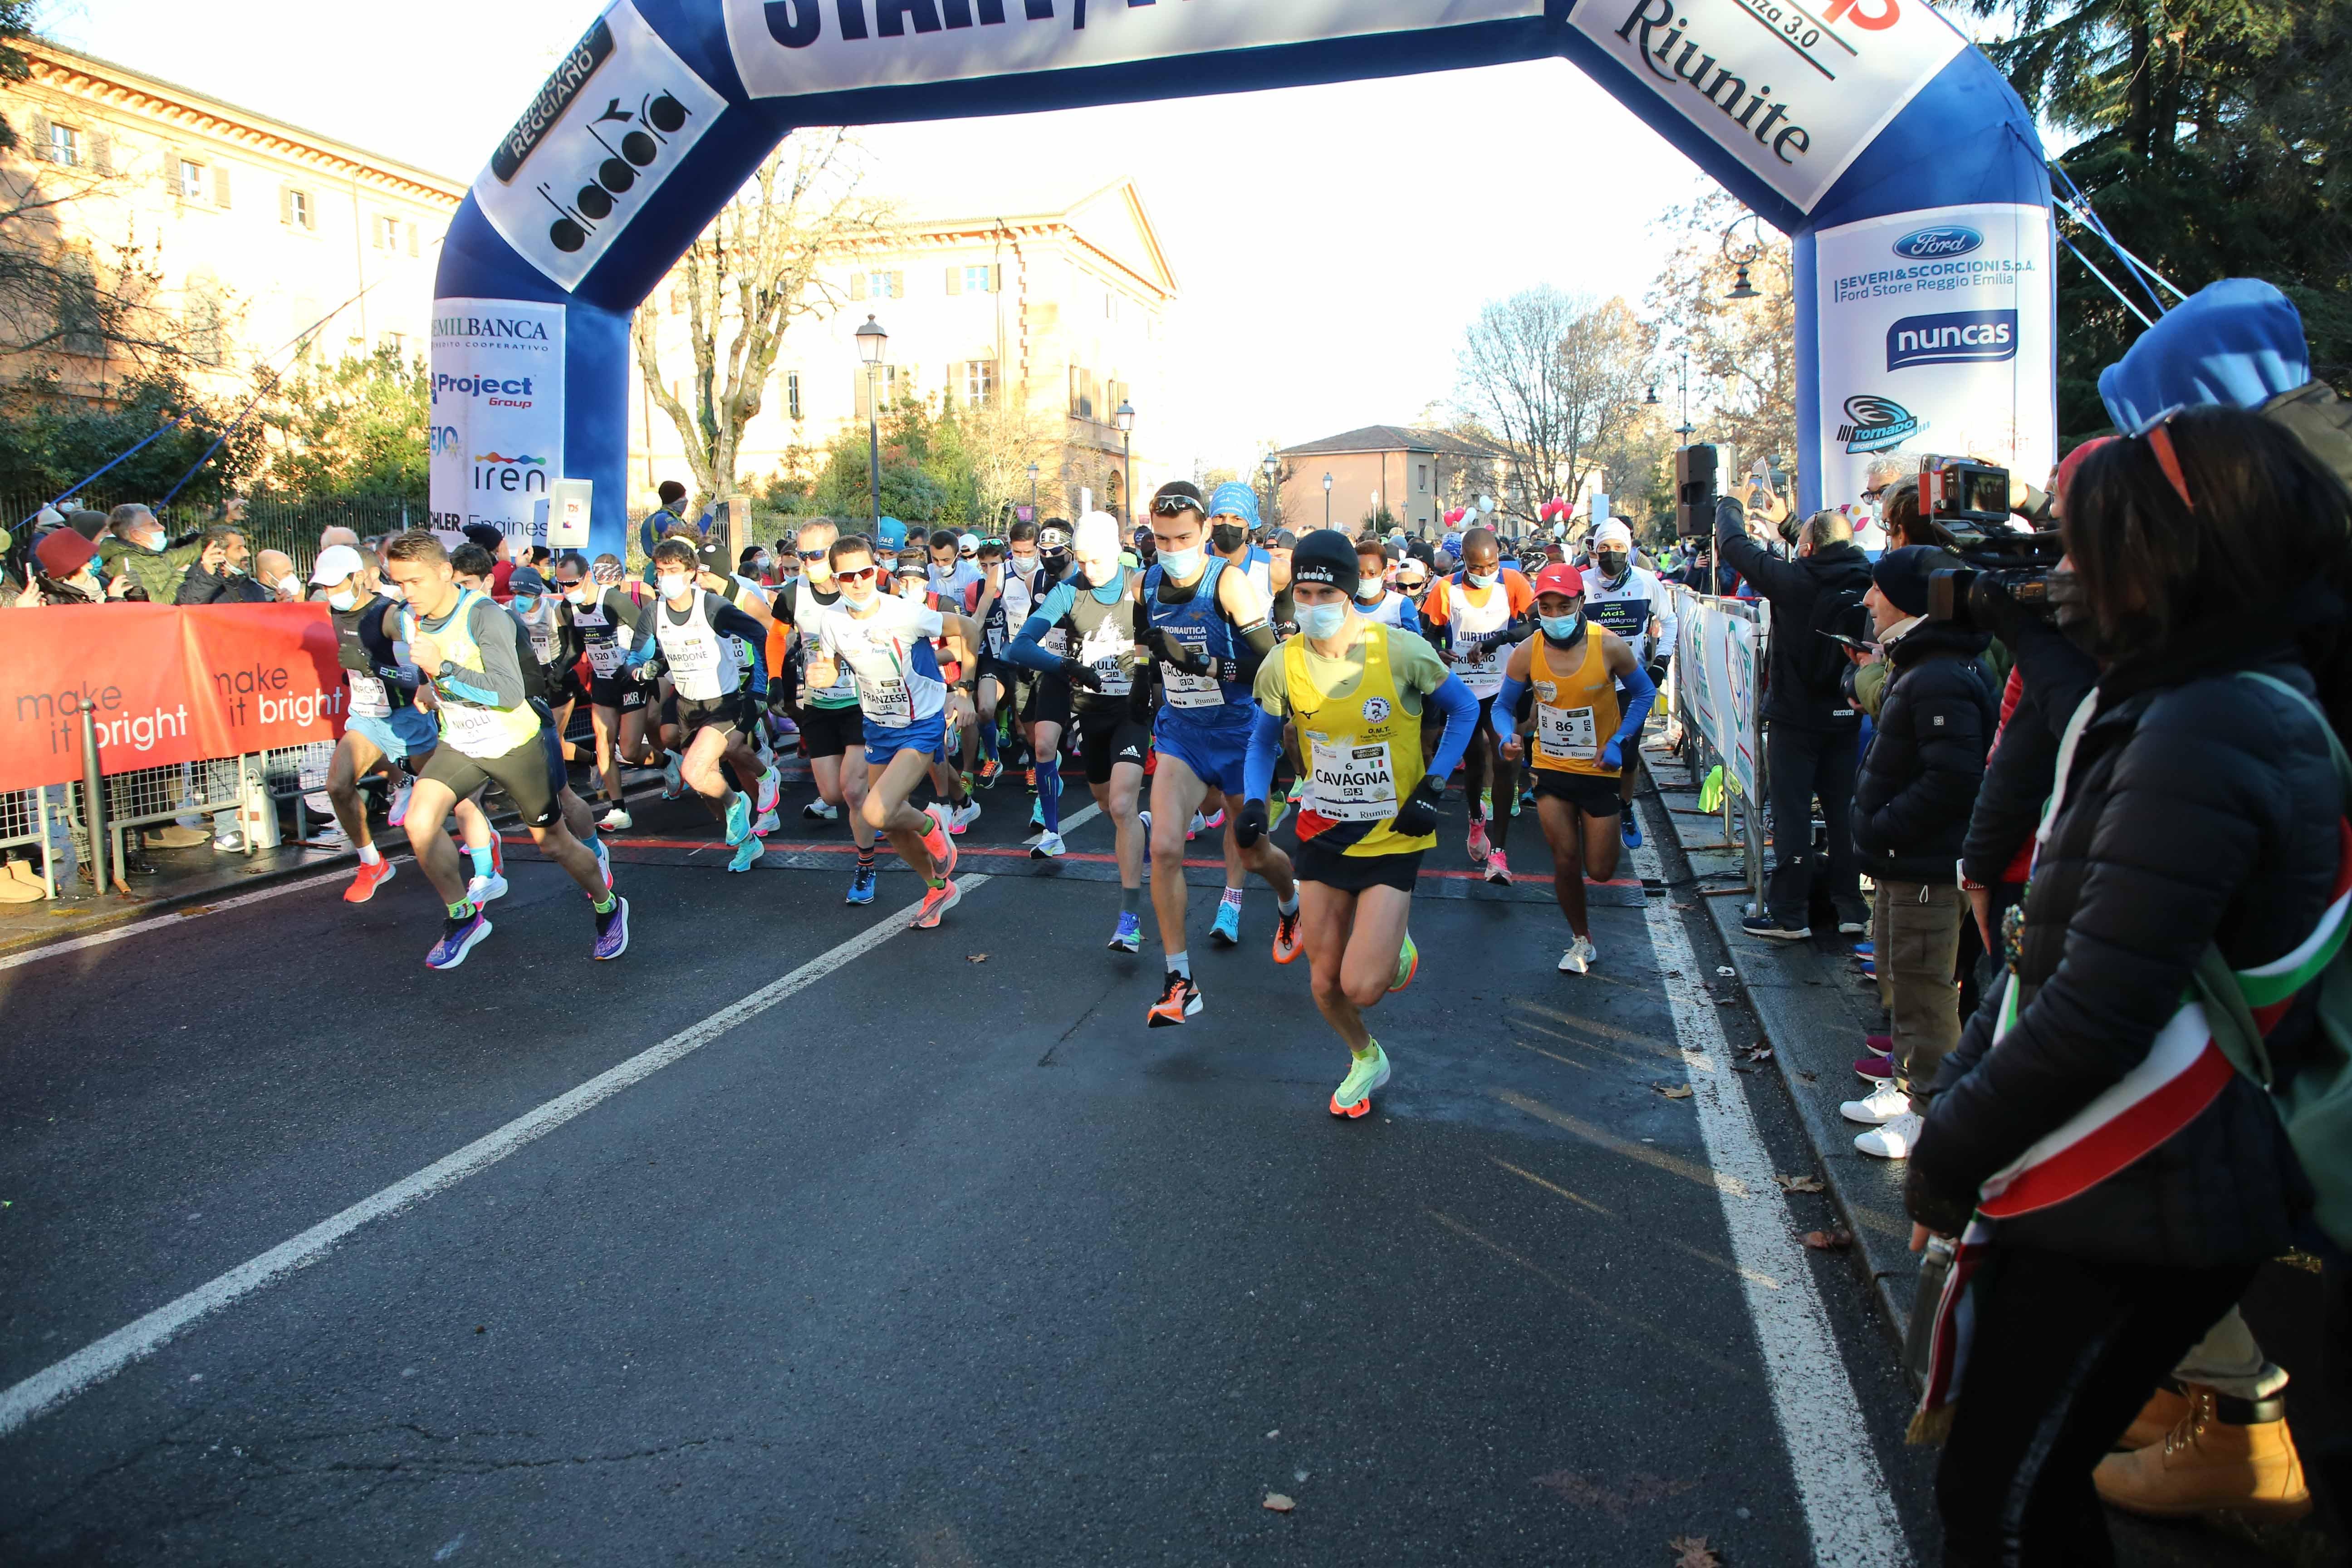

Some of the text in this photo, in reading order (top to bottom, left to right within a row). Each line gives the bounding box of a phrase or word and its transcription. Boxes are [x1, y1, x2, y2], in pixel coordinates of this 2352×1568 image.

[1784, 16, 1820, 49] 3.0
[1615, 0, 1811, 165] Riunite
[511, 50, 593, 159] REGGIANO
[537, 89, 692, 253] diadora
[1911, 231, 1965, 255] Ford
[1840, 260, 1999, 289] SEVERI&SCORCIONI
[1841, 273, 2014, 302] Ford Store Reggio Emilia
[466, 342, 549, 352] COOPERATIVO
[1897, 323, 2010, 352] nuncas
[438, 374, 532, 397] Project
[489, 397, 533, 409] Group
[1851, 442, 1874, 450] SPORT
[899, 564, 925, 573] balance
[1297, 565, 1333, 582] diadora
[667, 651, 708, 662] NARDONE
[1091, 661, 1118, 670] KULK
[17, 681, 122, 721] make
[230, 686, 343, 727] it bright
[623, 691, 639, 704] DKR
[863, 691, 908, 704] FRANZESE
[452, 715, 491, 730] NIKOLLI
[1555, 721, 1573, 731] 86
[50, 720, 72, 754] it
[1316, 769, 1390, 786] CAVAGNA
